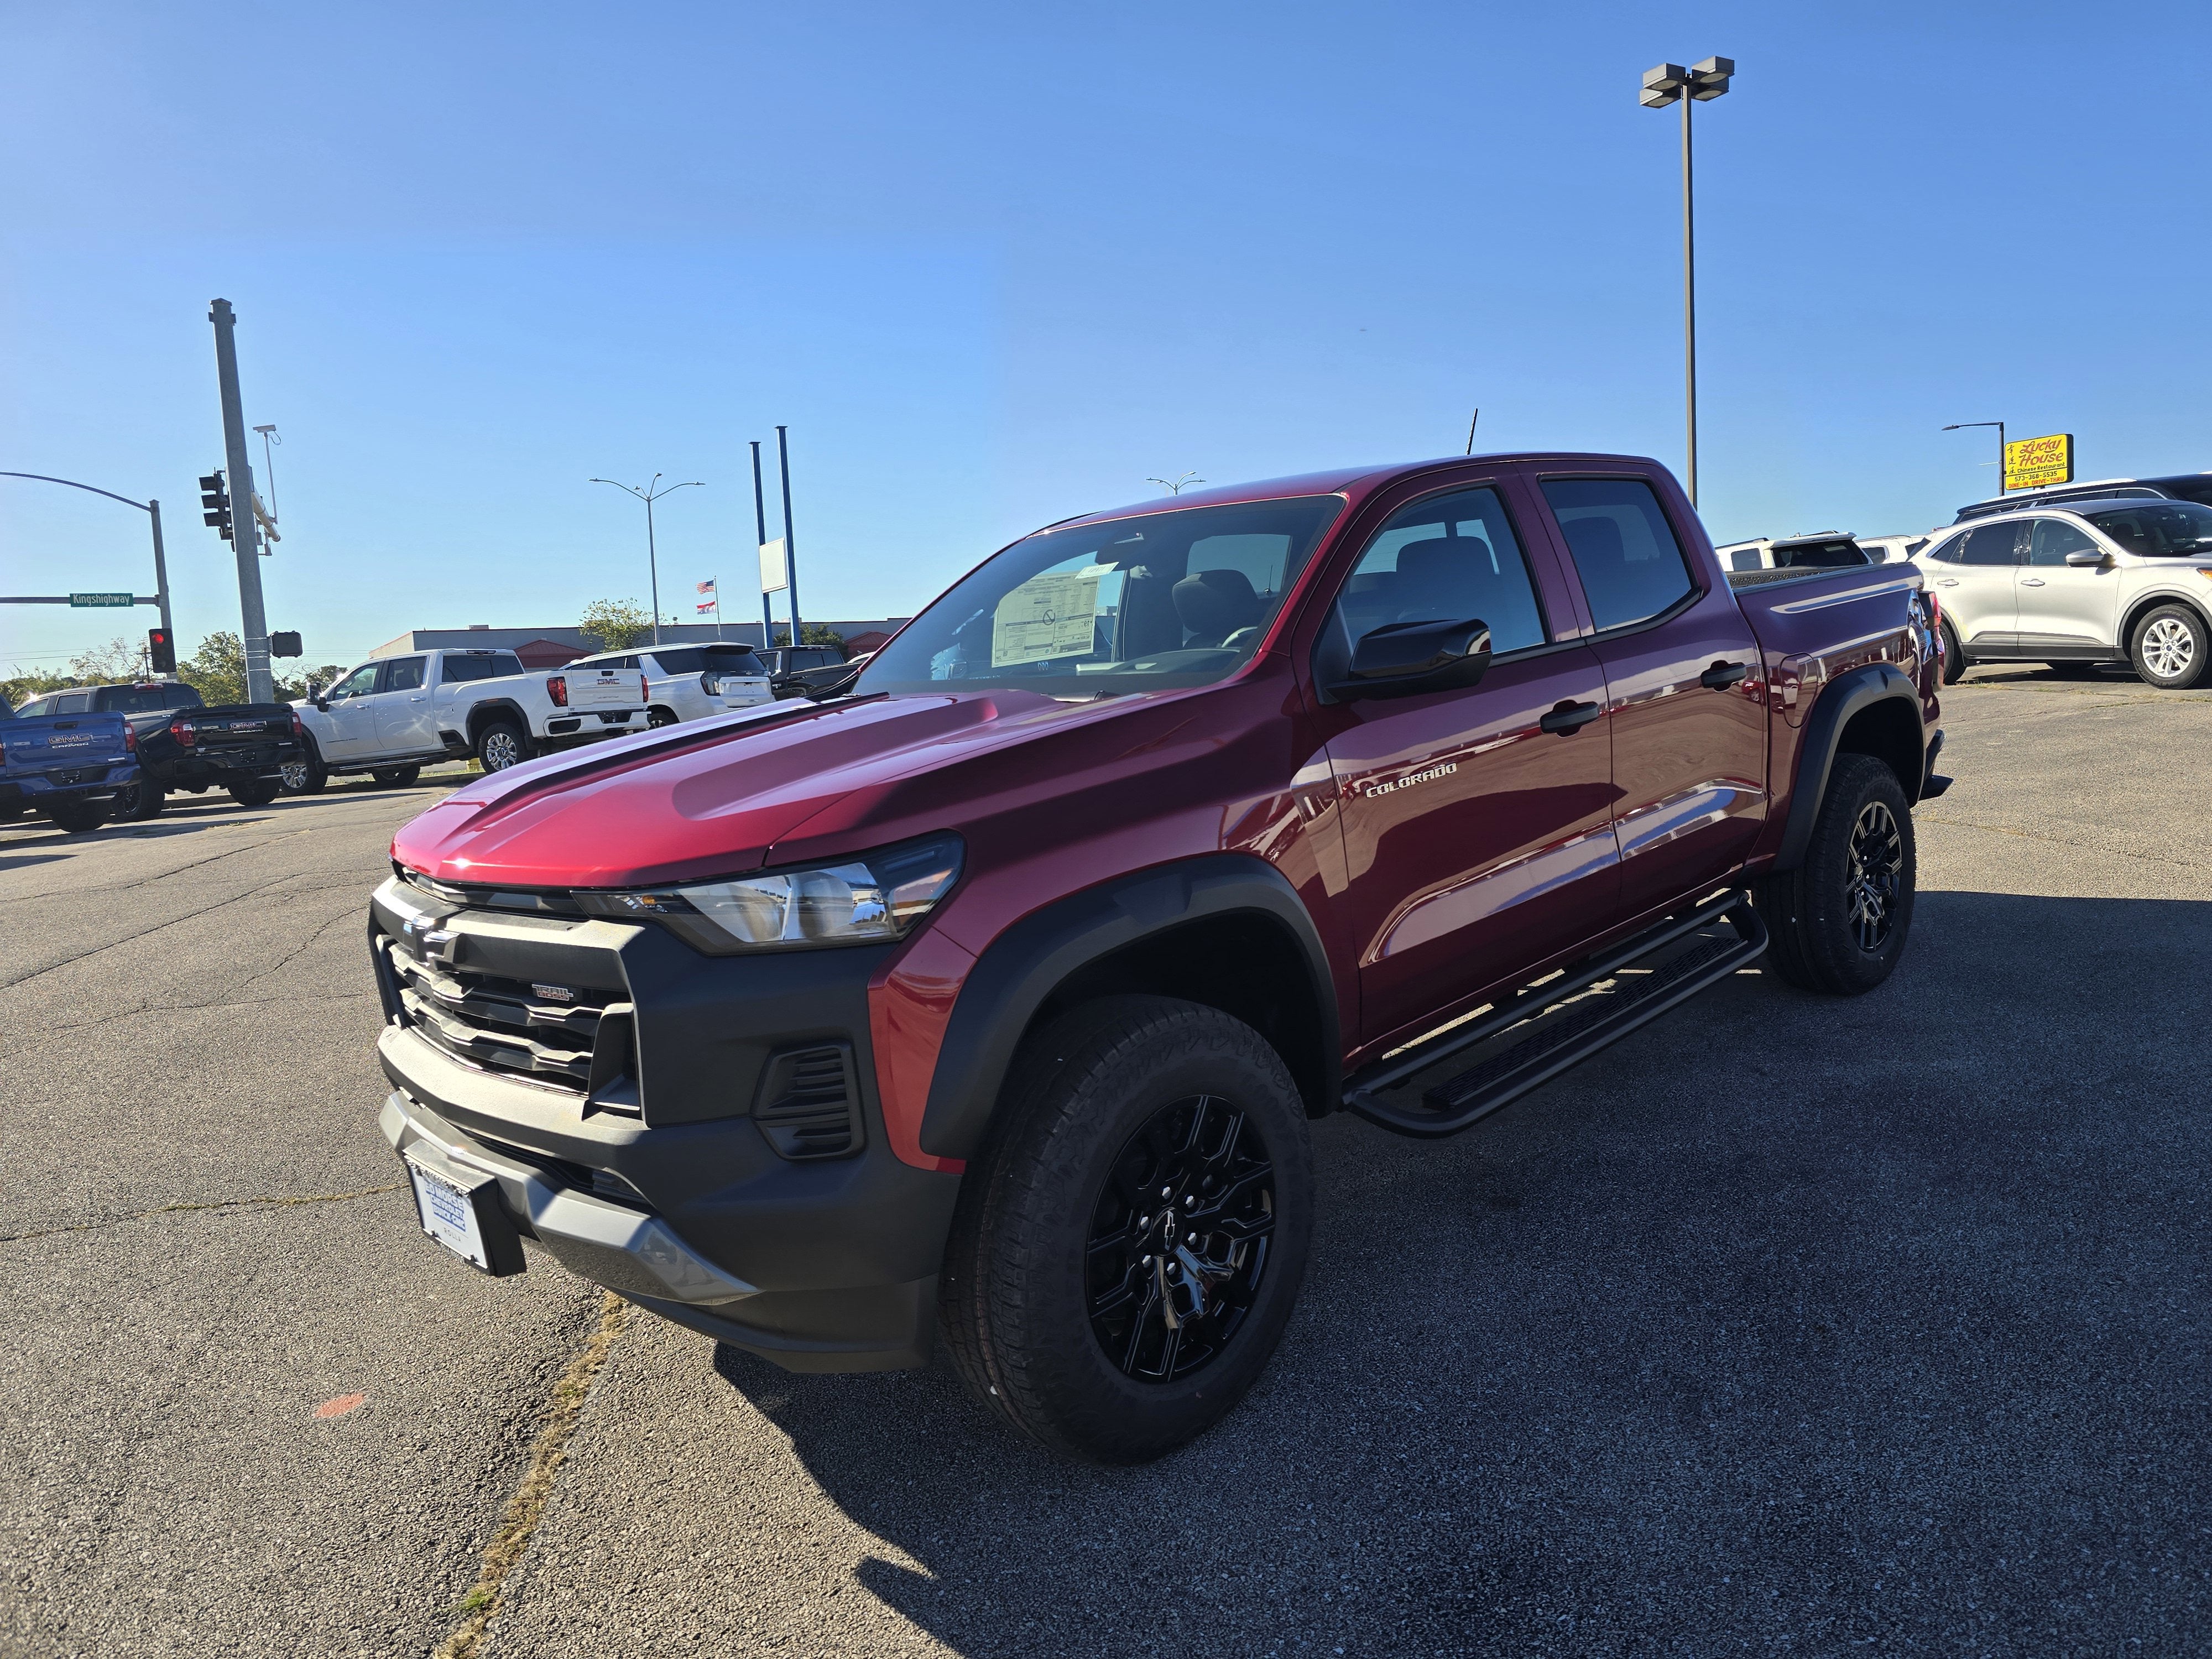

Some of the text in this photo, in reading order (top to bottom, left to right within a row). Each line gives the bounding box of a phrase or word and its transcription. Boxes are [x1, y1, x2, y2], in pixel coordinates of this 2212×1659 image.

[2020, 439, 2062, 454] Lucky
[2019, 452, 2063, 467] House
[2037, 462, 2065, 471] Restaurant
[2032, 476, 2064, 485] DRIVE-THRU
[73, 594, 129, 606] Kingshighway
[229, 721, 265, 730] GMC
[48, 733, 90, 744] GMC
[1366, 763, 1457, 798] COLORADO
[531, 984, 574, 997] TRAIL
[538, 992, 569, 1001] BOSS
[425, 1182, 464, 1211] ED MORSE
[430, 1194, 464, 1219] CHEVROLET
[444, 1228, 461, 1242] ROLLA
